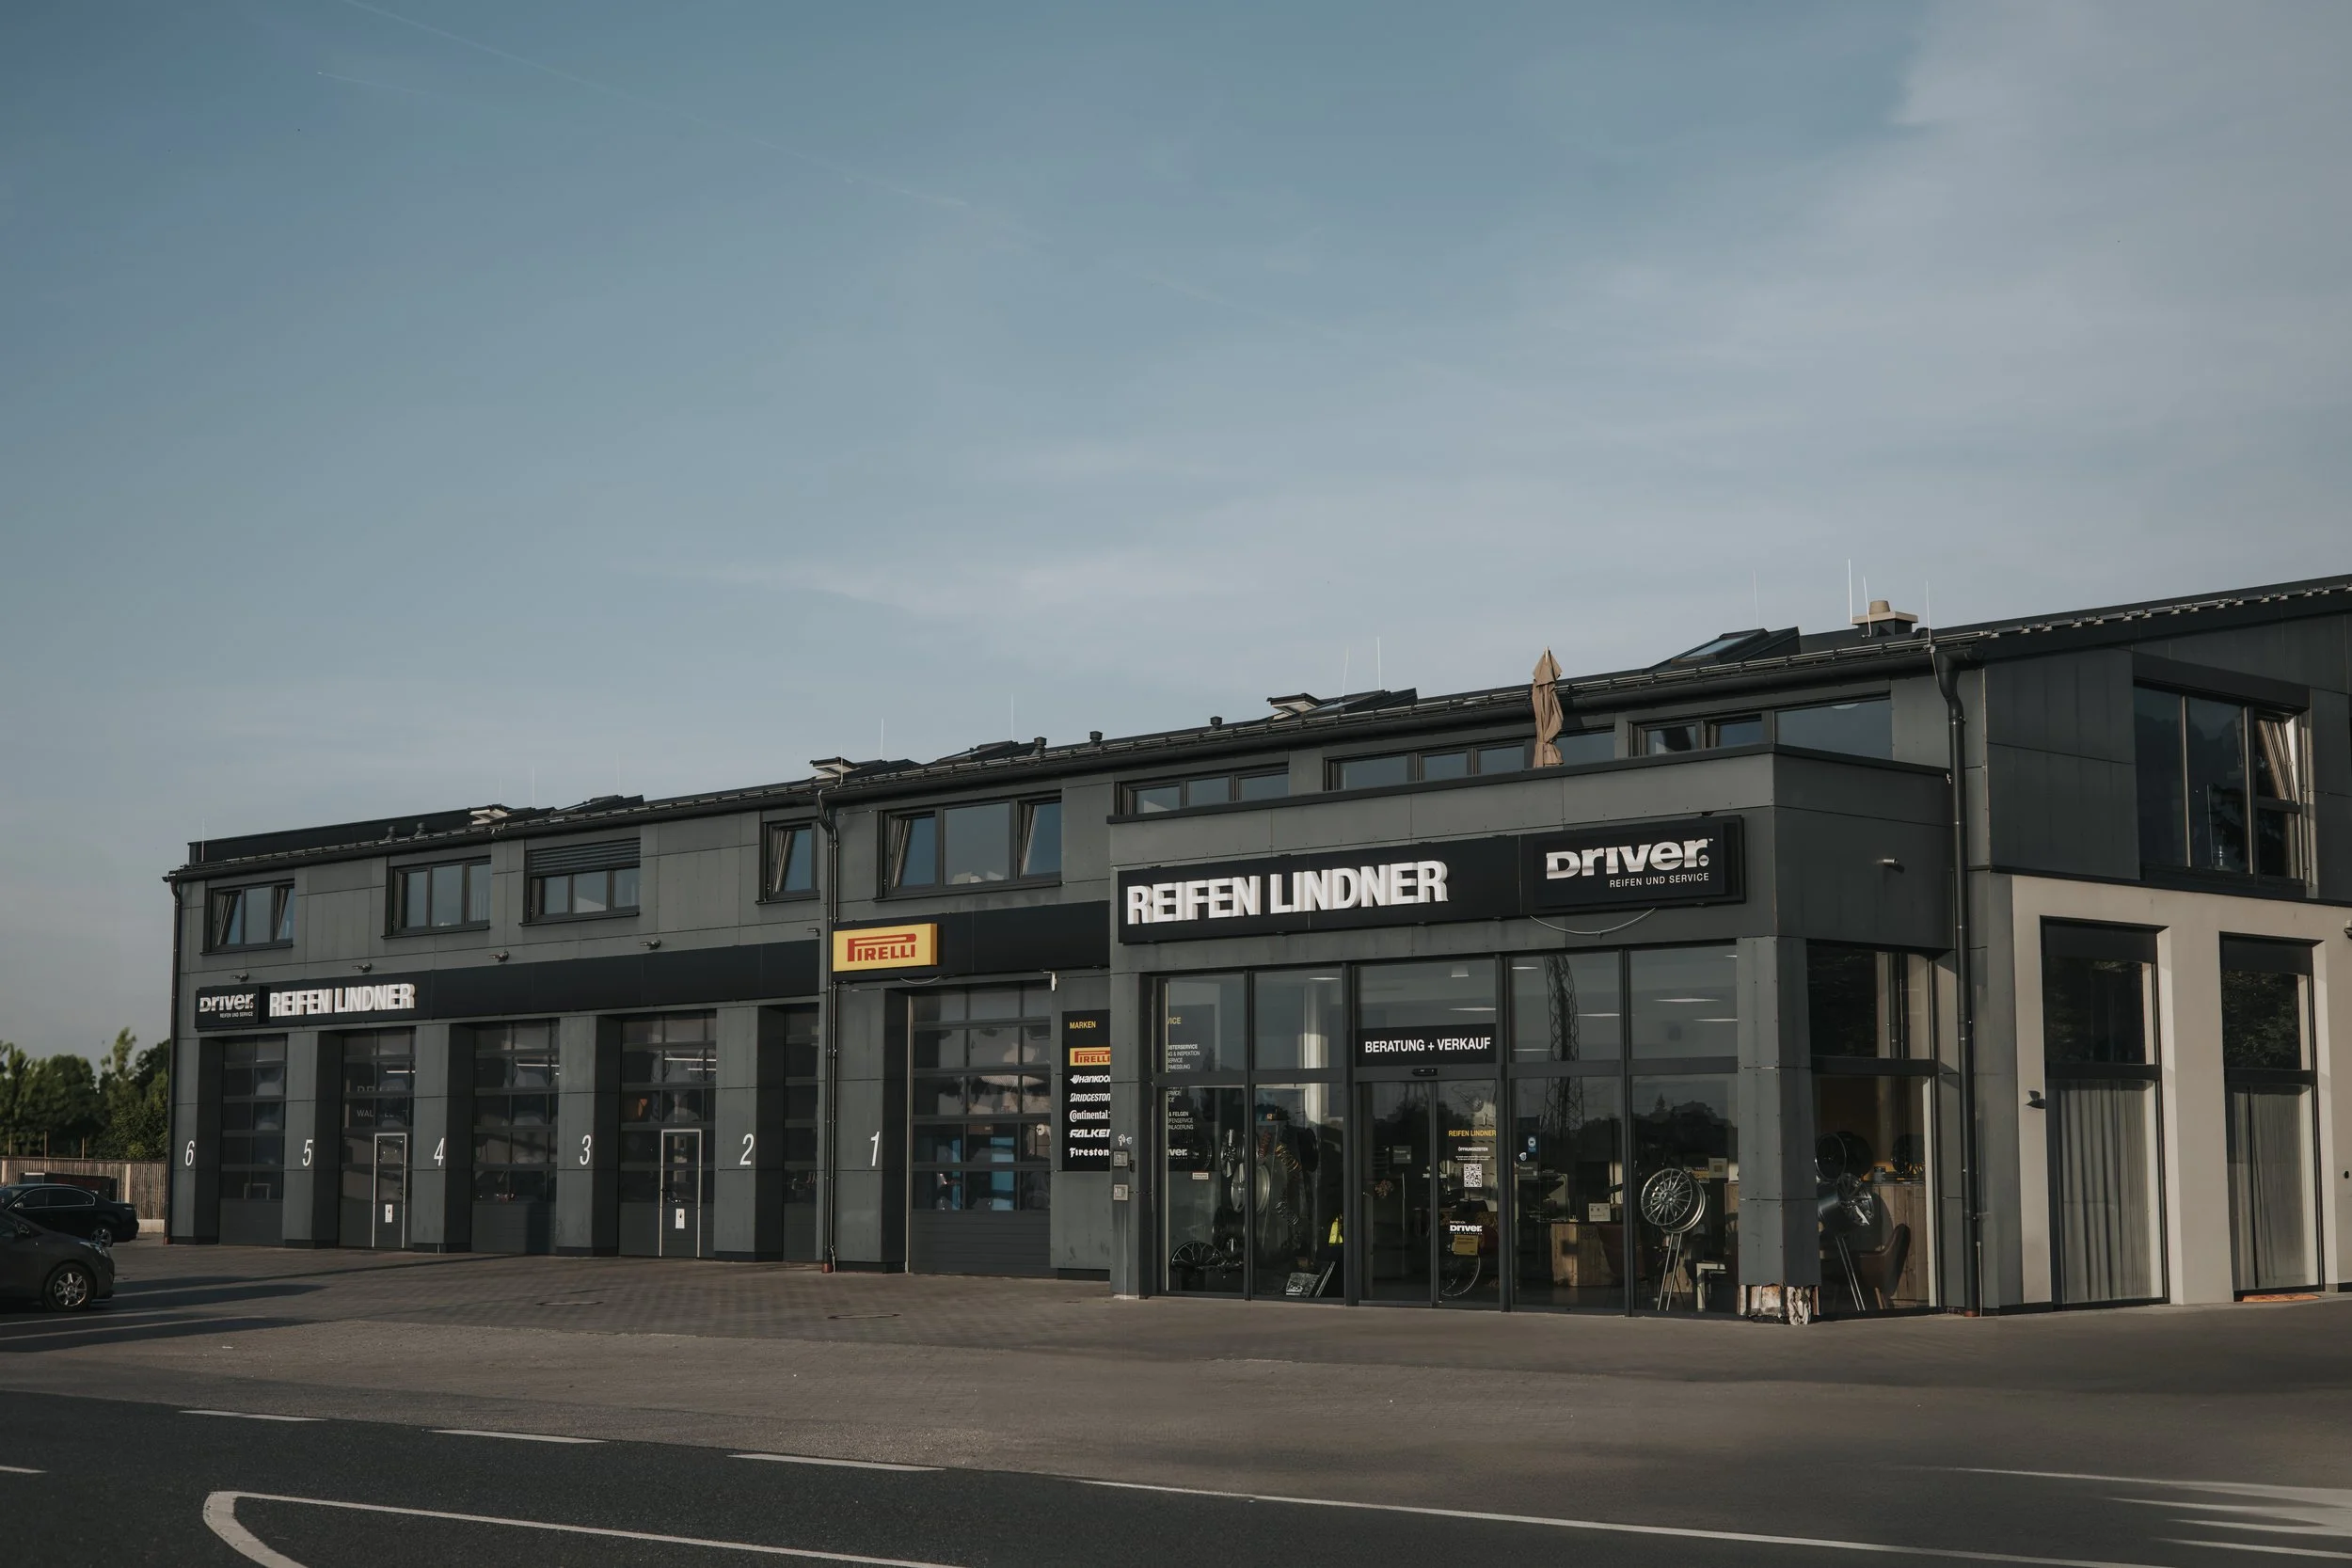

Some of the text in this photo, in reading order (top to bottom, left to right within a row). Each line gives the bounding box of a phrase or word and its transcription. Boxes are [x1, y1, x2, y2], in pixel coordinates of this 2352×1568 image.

[1127, 861, 1448, 925] REIFEN LINDNER
[1610, 873, 1709, 888] REIFEN UND SERVICE
[848, 933, 916, 962] PIRELLI
[269, 984, 415, 1017] REIFEN LINDNER
[1365, 1037, 1491, 1053] BERATUNG + VERKAUF
[1070, 1110, 1108, 1122] Continental
[184, 1140, 195, 1166] 6
[302, 1139, 313, 1166] 5
[434, 1137, 445, 1166] 4
[580, 1134, 592, 1165] 3
[739, 1133, 755, 1165] 2
[870, 1131, 880, 1166] 1
[1070, 1148, 1110, 1158] Fireston
